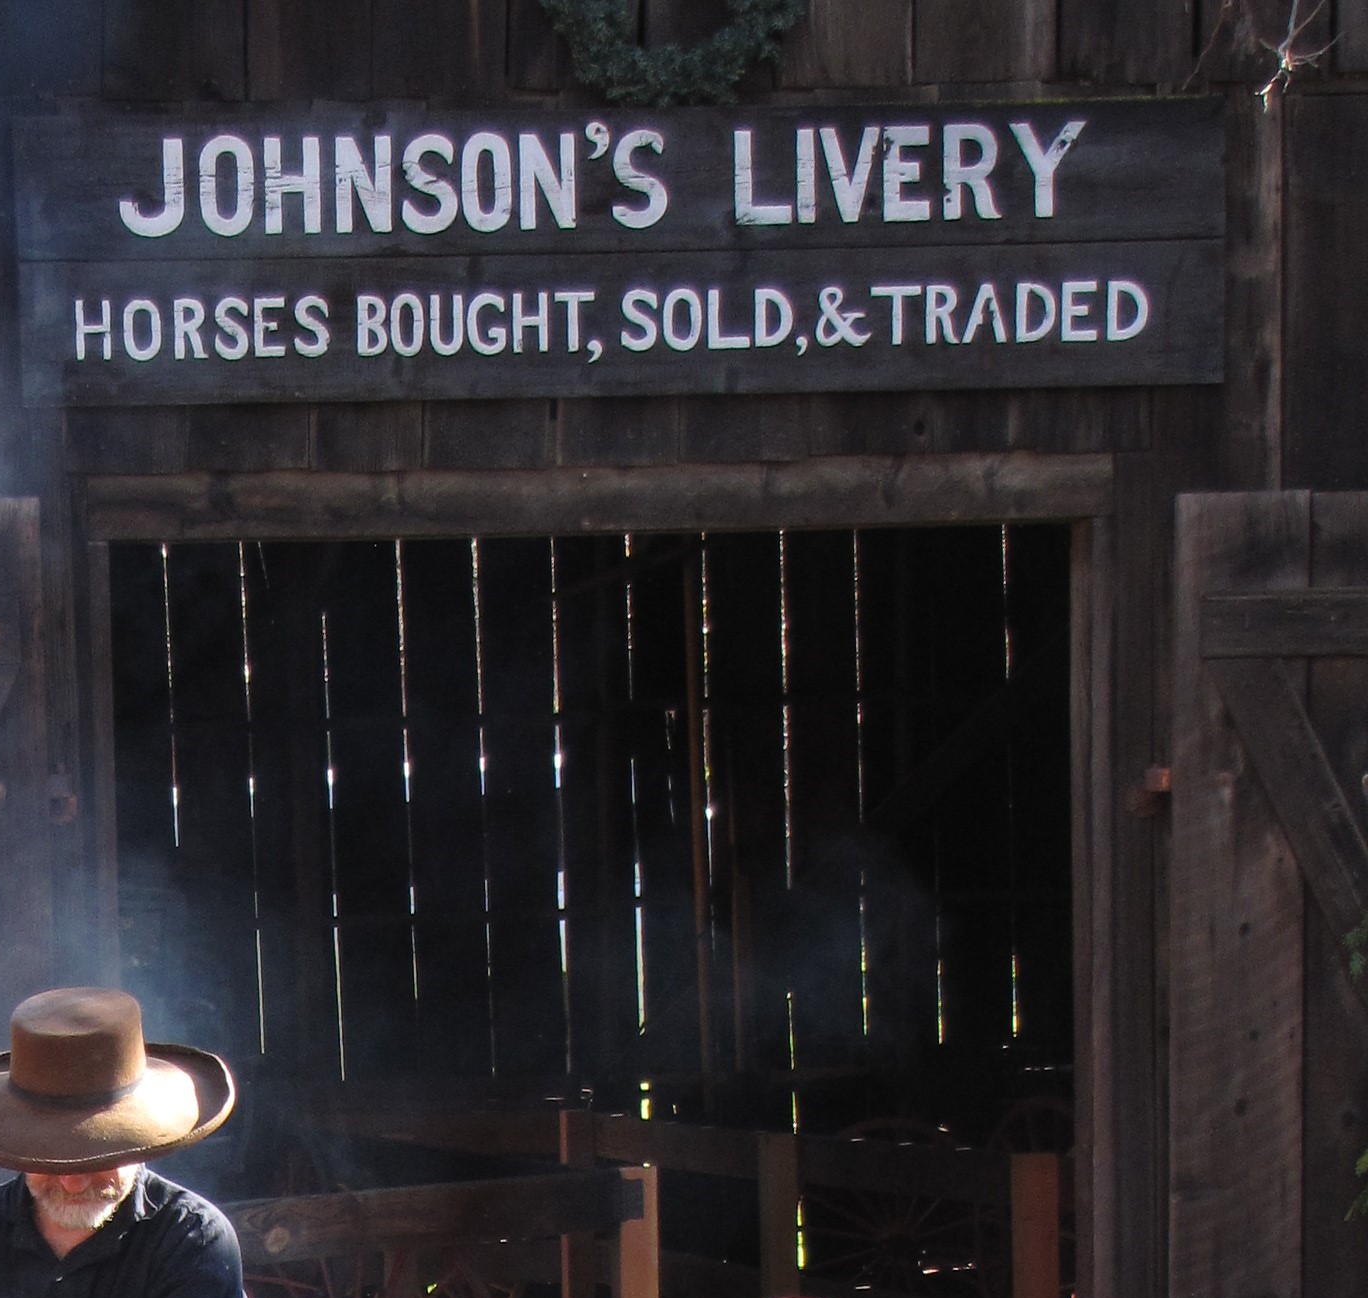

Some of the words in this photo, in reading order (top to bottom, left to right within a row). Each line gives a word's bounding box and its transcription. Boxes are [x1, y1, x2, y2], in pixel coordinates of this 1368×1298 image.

[119, 121, 669, 237] JOHNSON'S
[733, 120, 1087, 226] LIVERY
[74, 295, 331, 362] HORSES
[356, 290, 604, 364] BOUGHT,
[871, 280, 1149, 345] TRADED
